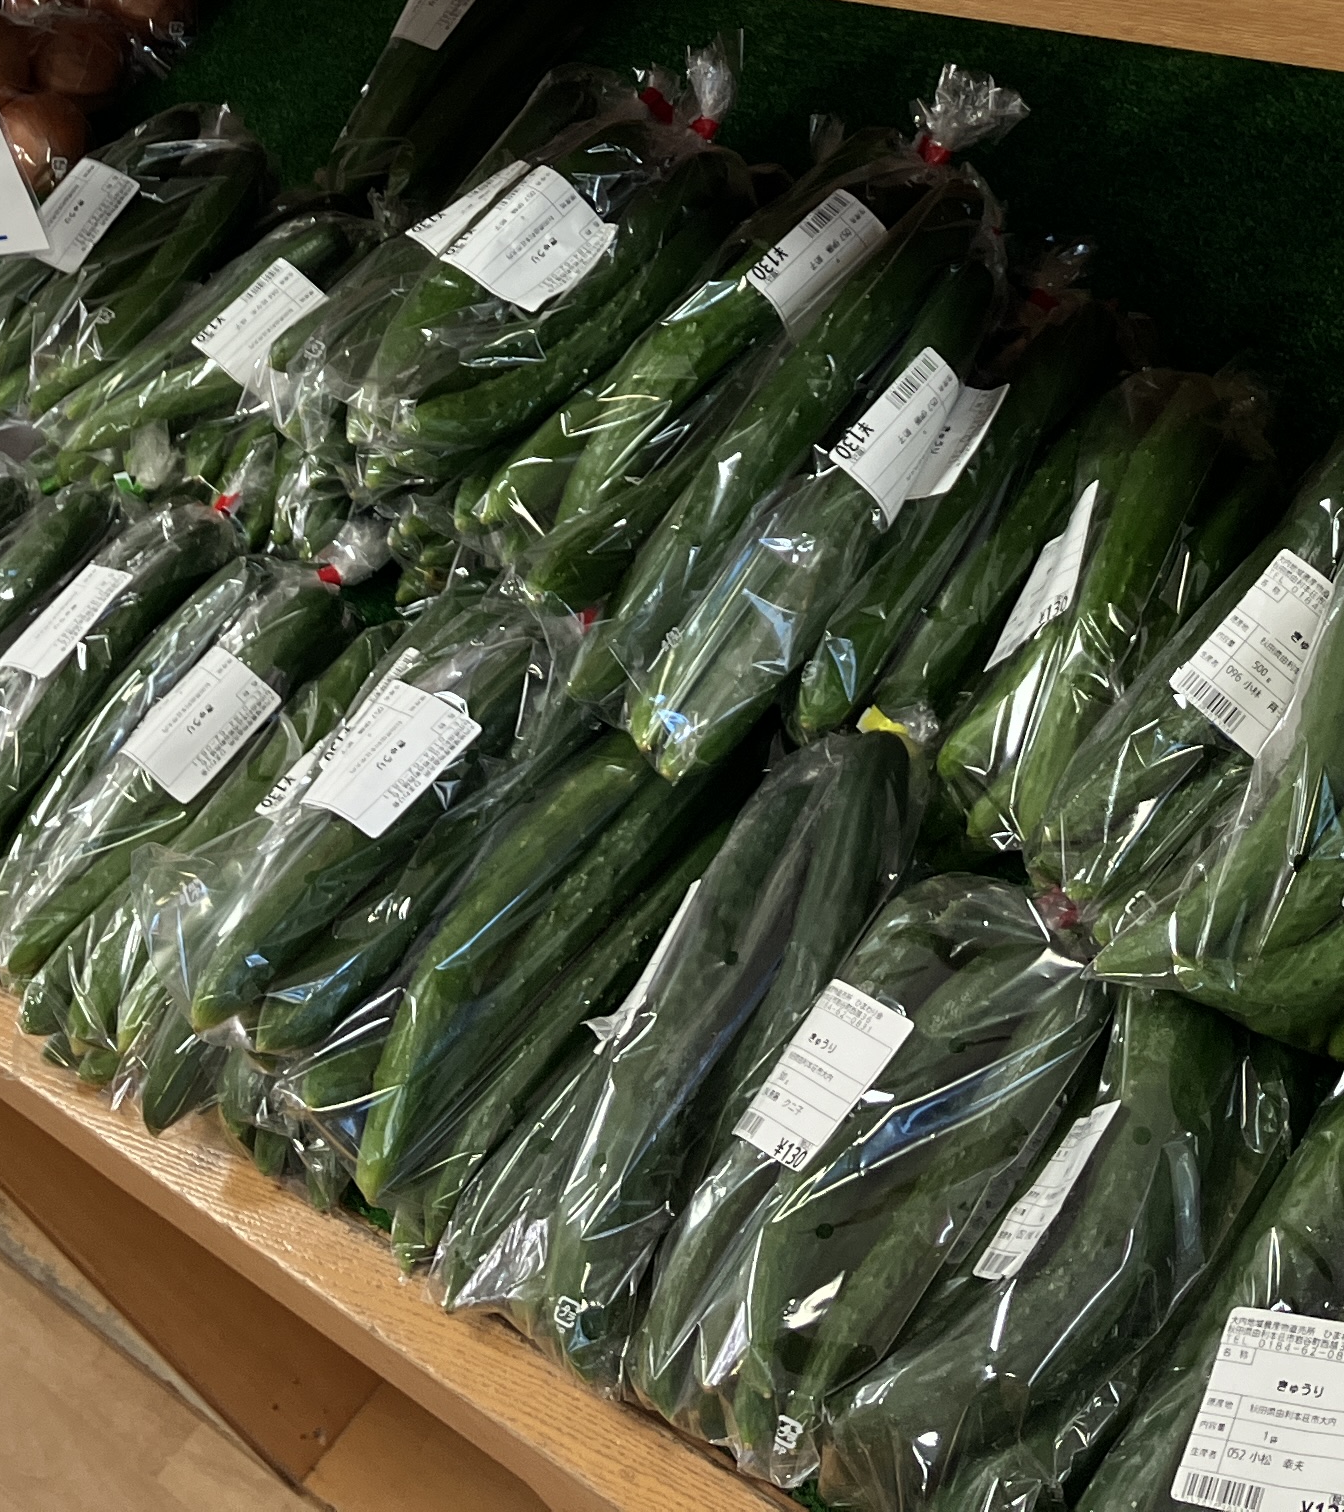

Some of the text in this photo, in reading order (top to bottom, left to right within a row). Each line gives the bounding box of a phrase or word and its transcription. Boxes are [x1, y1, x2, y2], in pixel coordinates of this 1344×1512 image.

[527, 235, 557, 265] きゅうり
[748, 241, 789, 283] ¥130
[832, 417, 875, 462] ¥130
[1225, 665, 1242, 682] 096
[1252, 660, 1269, 677] 500
[184, 702, 215, 735] きゅうり
[374, 737, 407, 772] きゅうり
[808, 1033, 837, 1053] きゅうり
[774, 1137, 808, 1168] ¥130
[1277, 1380, 1325, 1398] きゅうり
[1199, 1420, 1226, 1432] 内容量
[1206, 1397, 1337, 1427] 原産地 秋田県由利本荘市大内
[1190, 1447, 1305, 1471] 生産者 052 小松 幸夫
